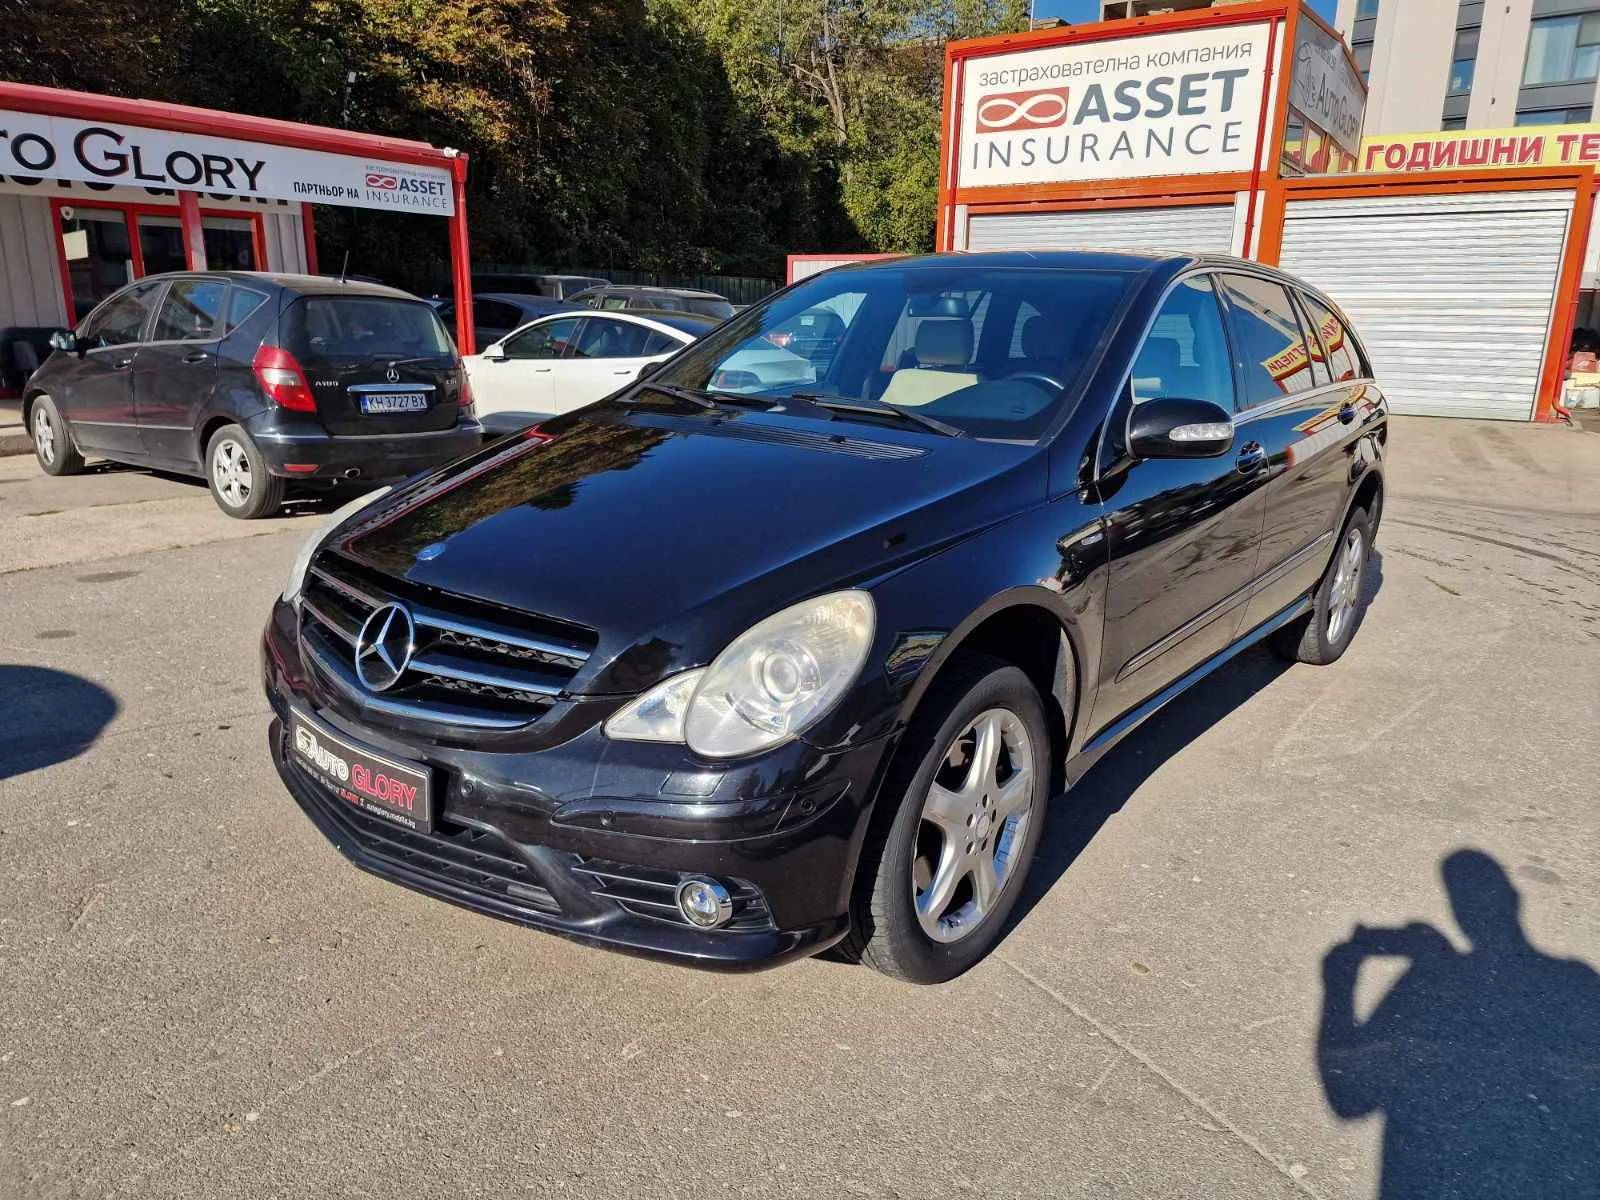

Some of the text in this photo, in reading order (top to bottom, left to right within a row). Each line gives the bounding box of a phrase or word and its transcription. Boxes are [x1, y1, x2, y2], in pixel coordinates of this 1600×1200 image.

[979, 42, 1252, 87] застрахователна компания
[1073, 69, 1249, 125] ASSET
[74, 127, 266, 191] GLORY
[973, 121, 1242, 169] INSURANCE
[1365, 136, 1545, 172] ГОДИШНИ
[1557, 134, 1600, 161] ТЕ
[294, 181, 344, 197] ПАРТНЬОР
[347, 188, 359, 199] НА
[366, 190, 448, 209] INSURANCE
[400, 178, 446, 196] ASSET
[385, 395, 408, 408] 3727
[352, 764, 417, 811] GLORY
